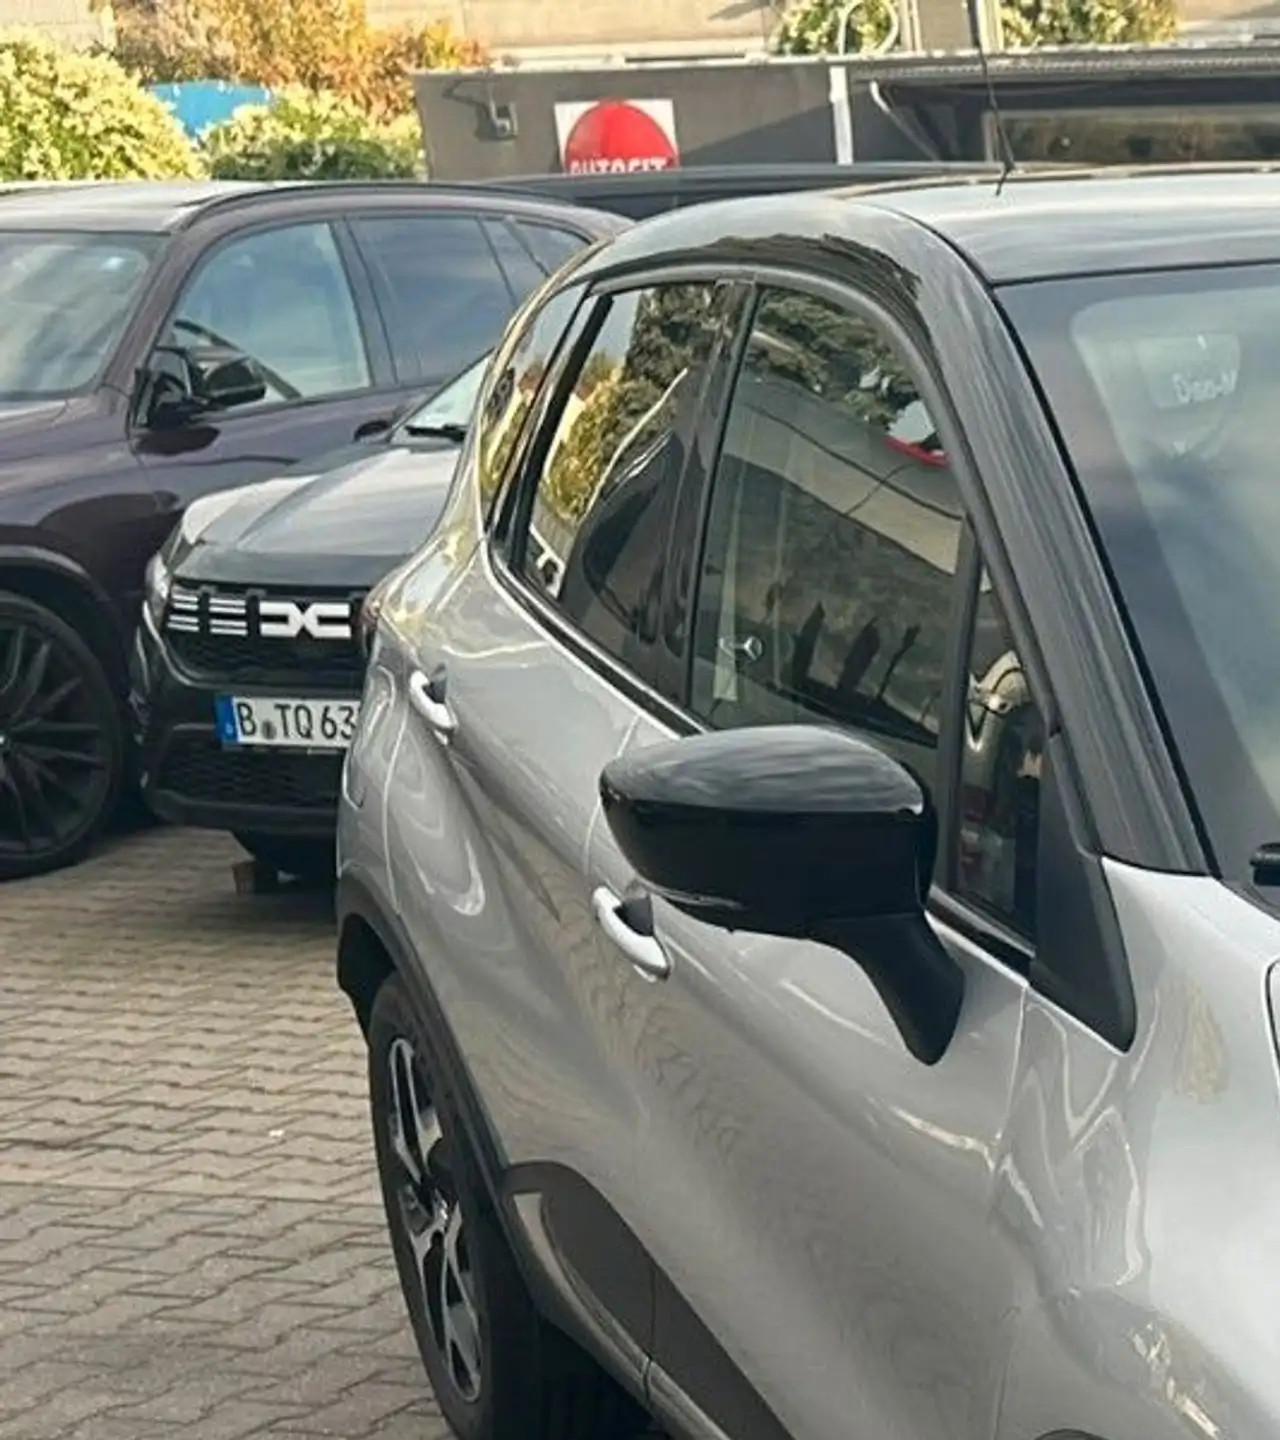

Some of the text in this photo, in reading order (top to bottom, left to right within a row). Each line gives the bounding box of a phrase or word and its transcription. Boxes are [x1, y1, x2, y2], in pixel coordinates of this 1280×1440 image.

[236, 702, 359, 739] B TQ 63
